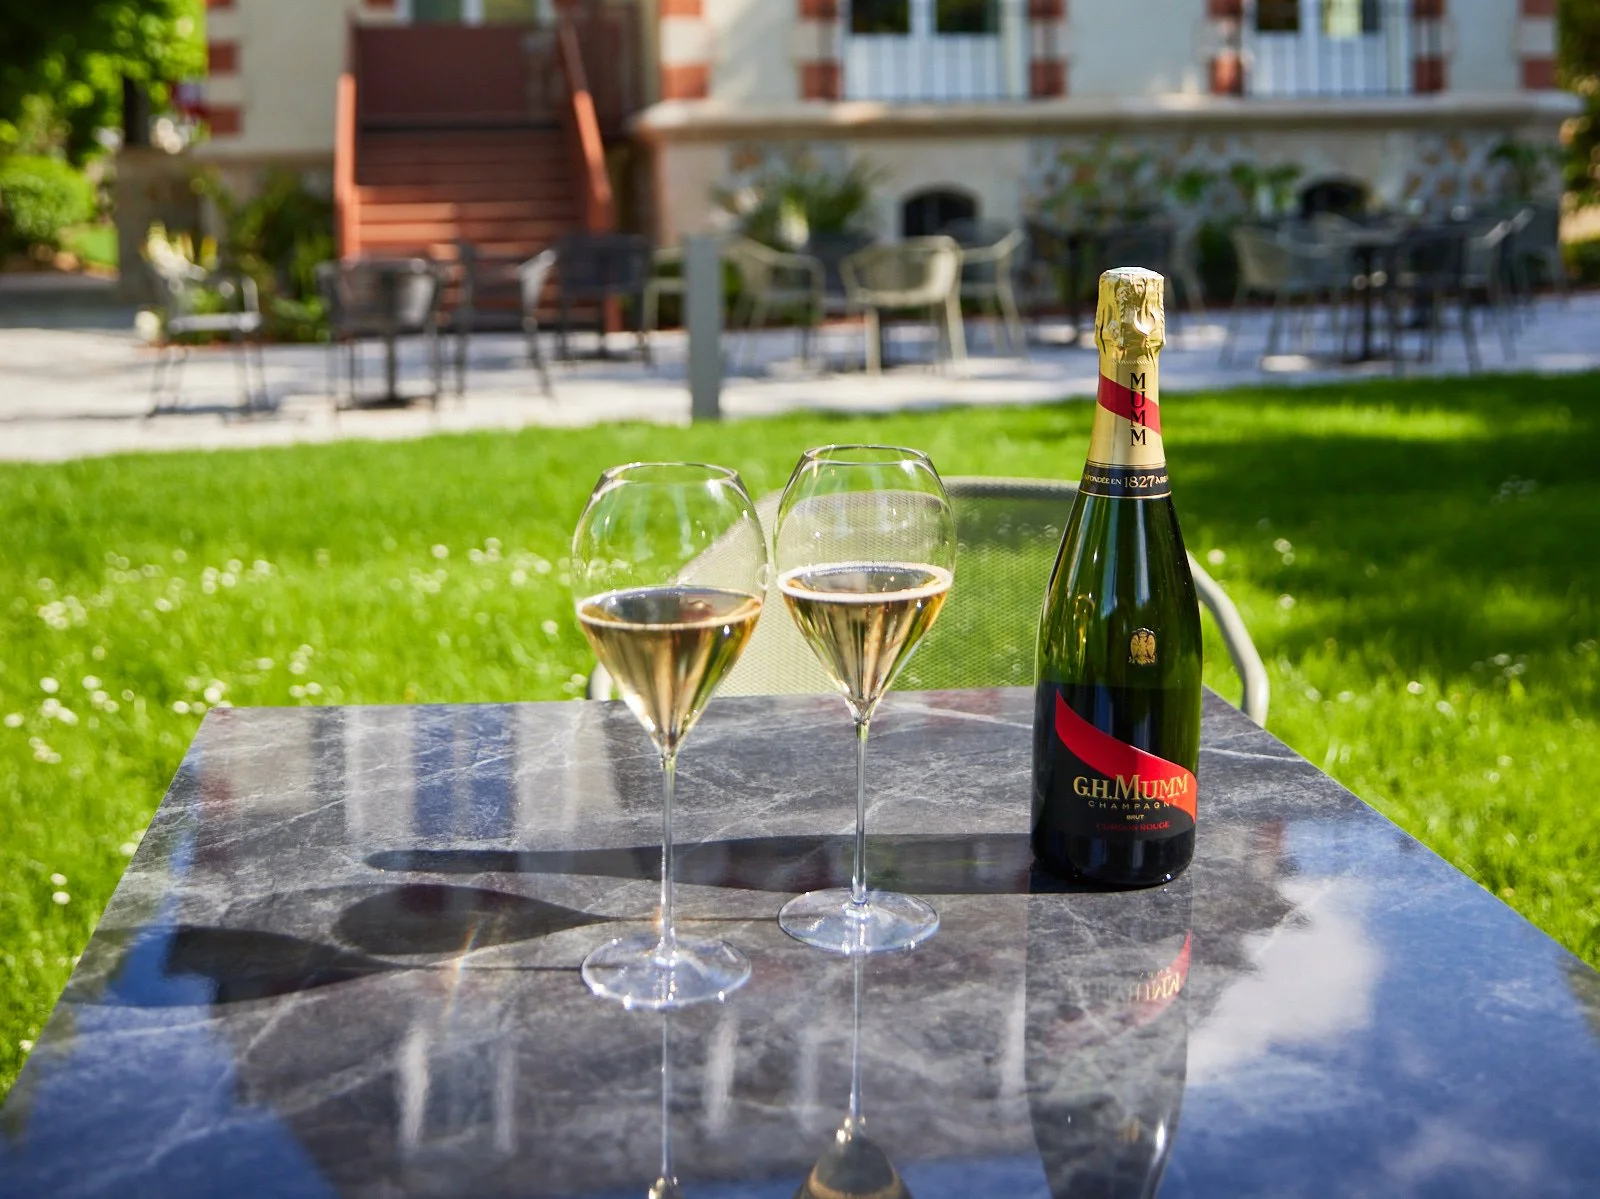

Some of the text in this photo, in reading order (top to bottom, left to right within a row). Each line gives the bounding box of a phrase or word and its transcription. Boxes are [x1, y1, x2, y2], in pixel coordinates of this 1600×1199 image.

[1130, 372, 1147, 446] MUMM
[1124, 475, 1155, 488] 1827
[1140, 821, 1170, 831] ROUGE
